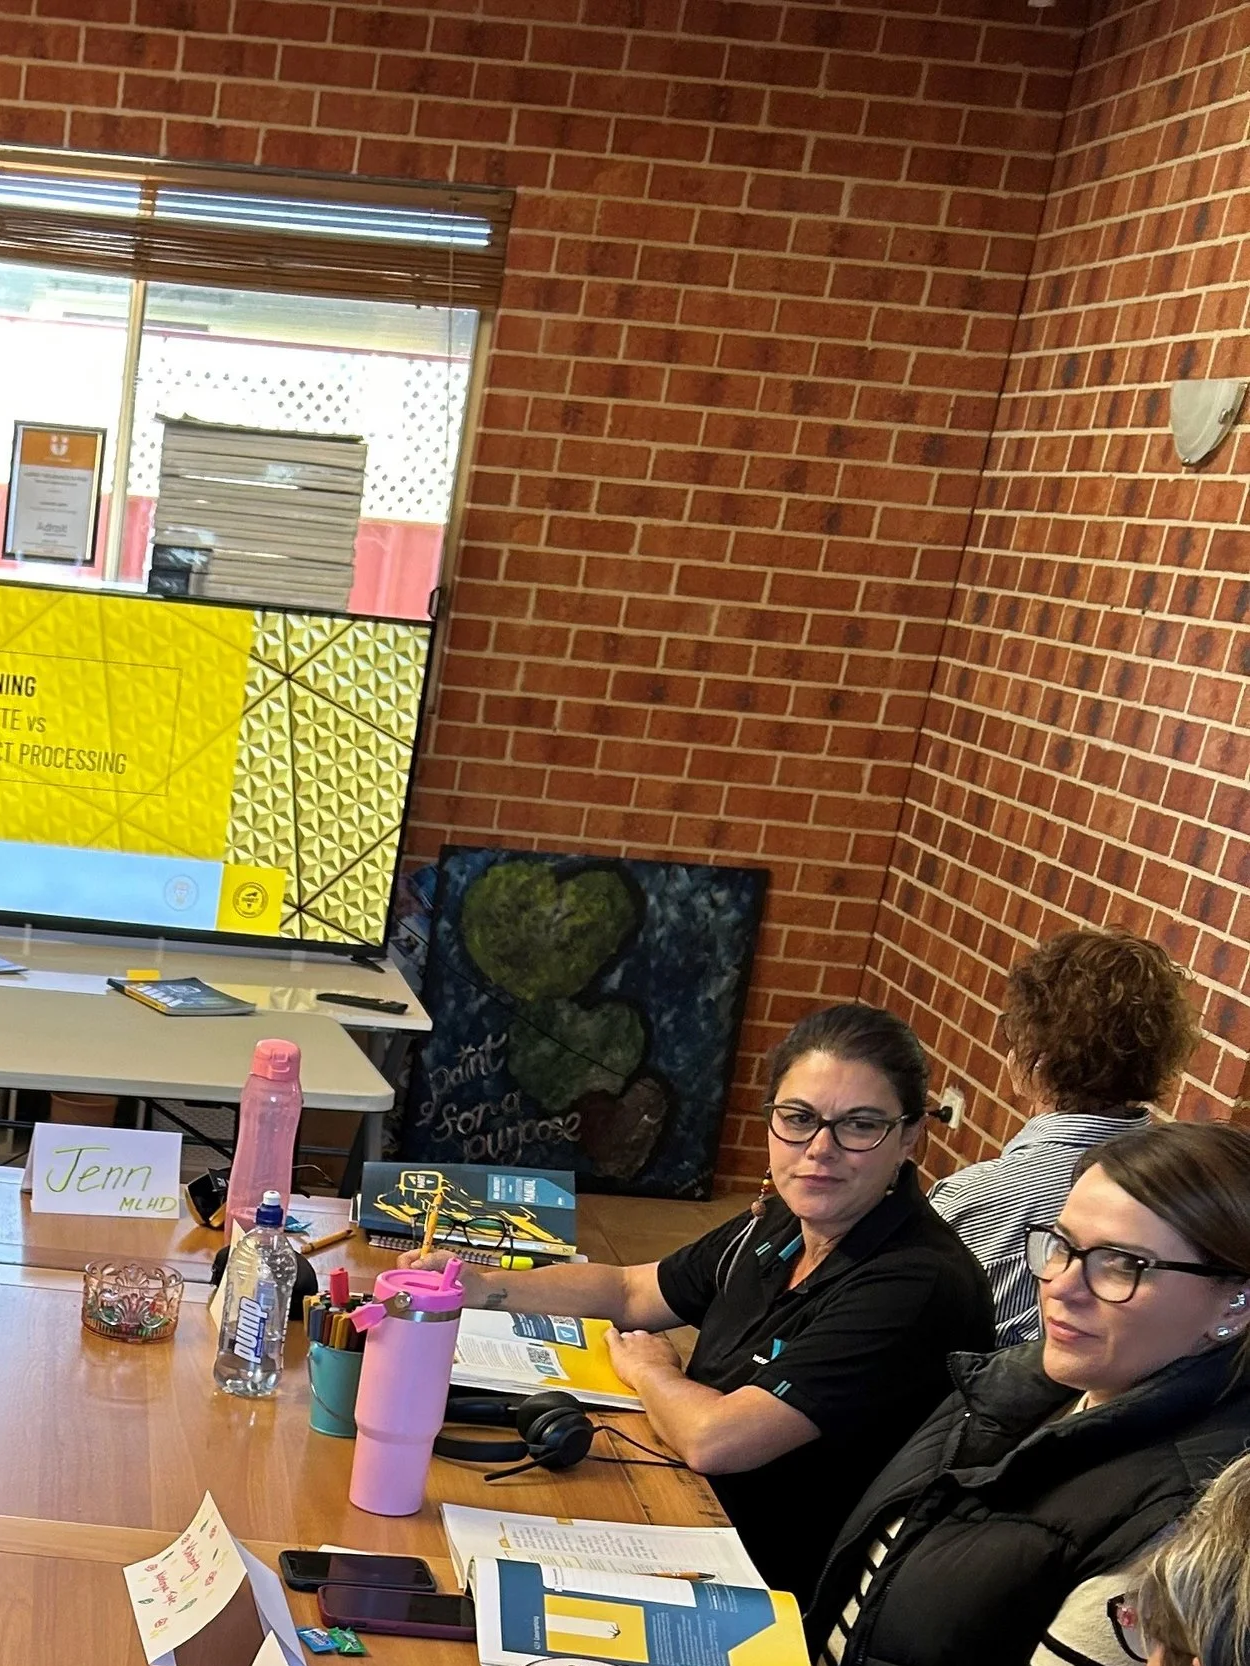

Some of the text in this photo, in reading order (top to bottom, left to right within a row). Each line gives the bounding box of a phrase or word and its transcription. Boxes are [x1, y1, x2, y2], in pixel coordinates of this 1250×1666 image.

[18, 743, 127, 775] PROCESSING
[46, 1147, 152, 1193] Jenn
[118, 1196, 178, 1213] MLHD
[234, 1296, 268, 1365] pump
